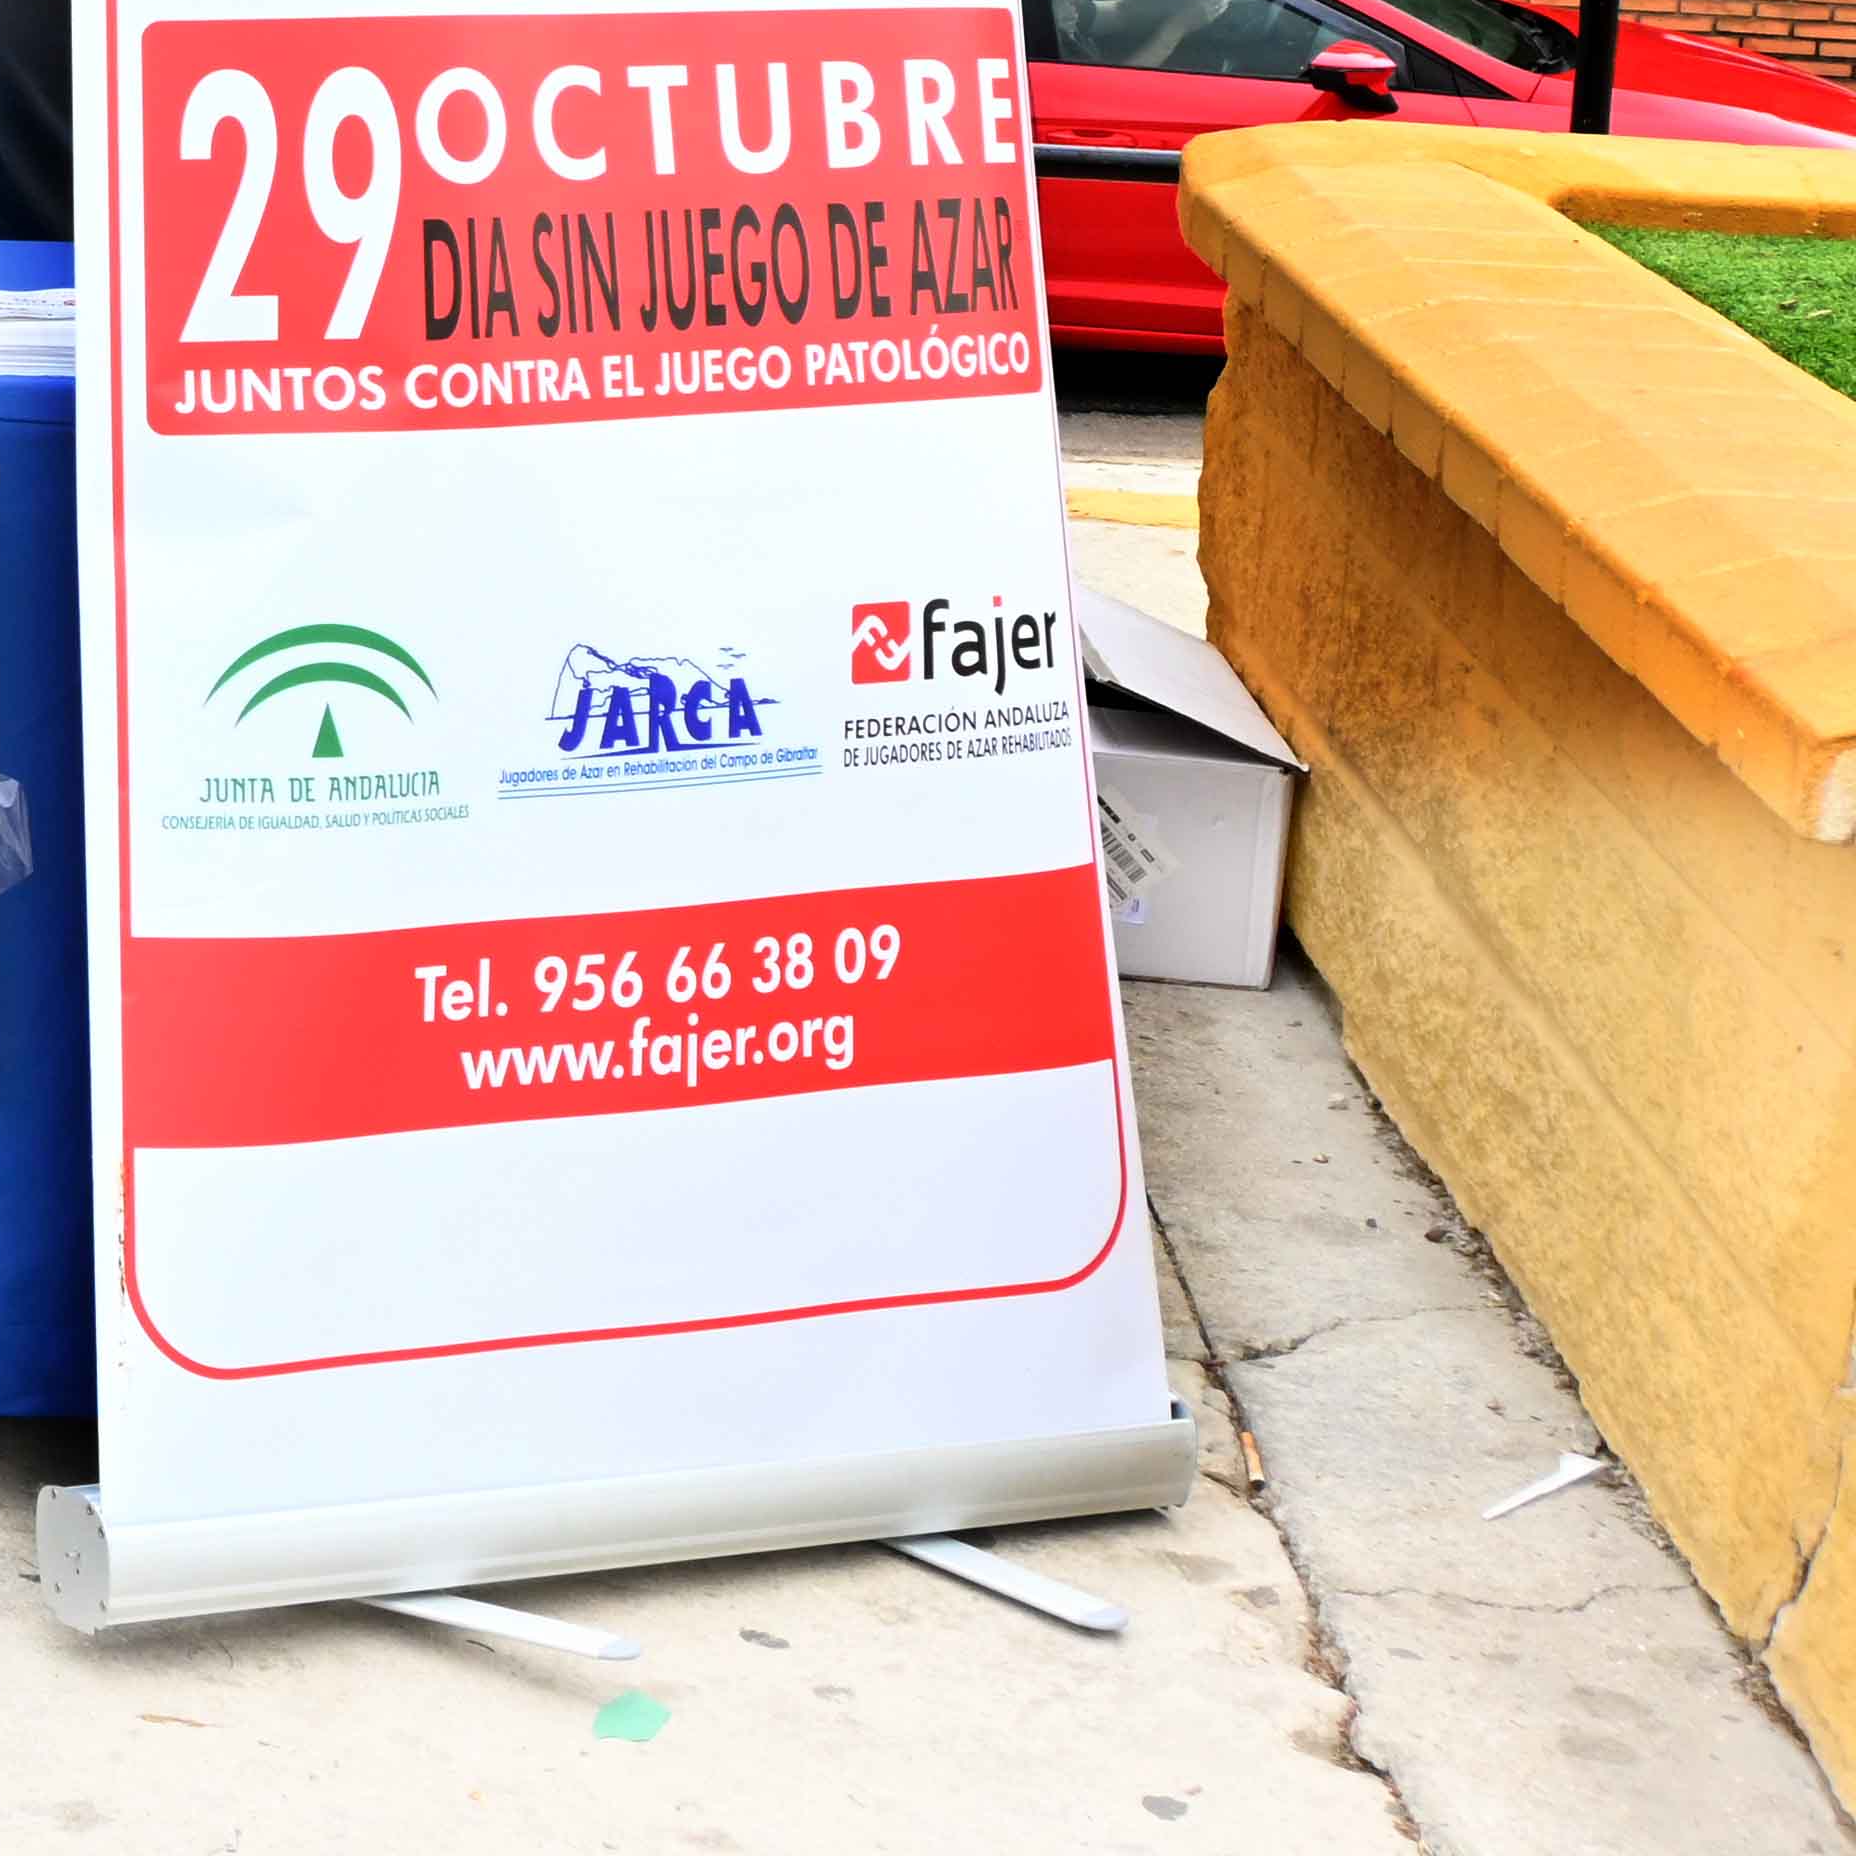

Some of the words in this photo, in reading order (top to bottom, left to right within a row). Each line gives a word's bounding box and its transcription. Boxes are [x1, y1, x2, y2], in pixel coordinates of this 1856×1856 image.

[178, 65, 402, 344] 29
[414, 57, 1017, 186] OCTUBRE
[422, 216, 521, 342] DIA
[532, 211, 621, 339] SIN
[639, 202, 811, 333] JUEGO
[826, 200, 892, 321] DE
[909, 196, 1019, 316] AZAR
[174, 365, 387, 415] JUNTOS
[404, 357, 592, 410] CONTRA
[602, 353, 645, 400] EL
[654, 345, 793, 396] JUEGO
[804, 322, 1031, 387] PATOLÓGICO
[923, 594, 1057, 697] fajer
[557, 672, 763, 753] JARCA
[843, 747, 860, 768] DE
[863, 741, 942, 767] JUGADORES
[946, 740, 963, 760] DE
[967, 736, 998, 758] AZAR
[1002, 727, 1072, 755] REHABILITADOS
[844, 704, 977, 740] FEDERACIÓN
[984, 700, 1070, 730] ANDALUZA
[200, 777, 276, 804] JUNTA
[288, 777, 316, 803] DE
[498, 764, 559, 787] Jugadores
[562, 763, 578, 781] de
[580, 762, 604, 779] Azar
[607, 763, 621, 777] en
[701, 753, 717, 771] del
[719, 752, 758, 772] Campo
[760, 749, 774, 765] de
[776, 746, 819, 764] Gibraltar
[238, 815, 256, 831] DE
[257, 814, 322, 831] IGUALDAD,
[325, 812, 361, 828] SALUD
[362, 812, 372, 827] Y
[423, 804, 470, 823] SOCIALES
[414, 957, 509, 1024] Tel.
[533, 950, 644, 1014] 956
[664, 942, 733, 1005] 66
[751, 932, 815, 994] 38
[834, 923, 902, 985] 09
[459, 1011, 856, 1090] www.fajer.org
